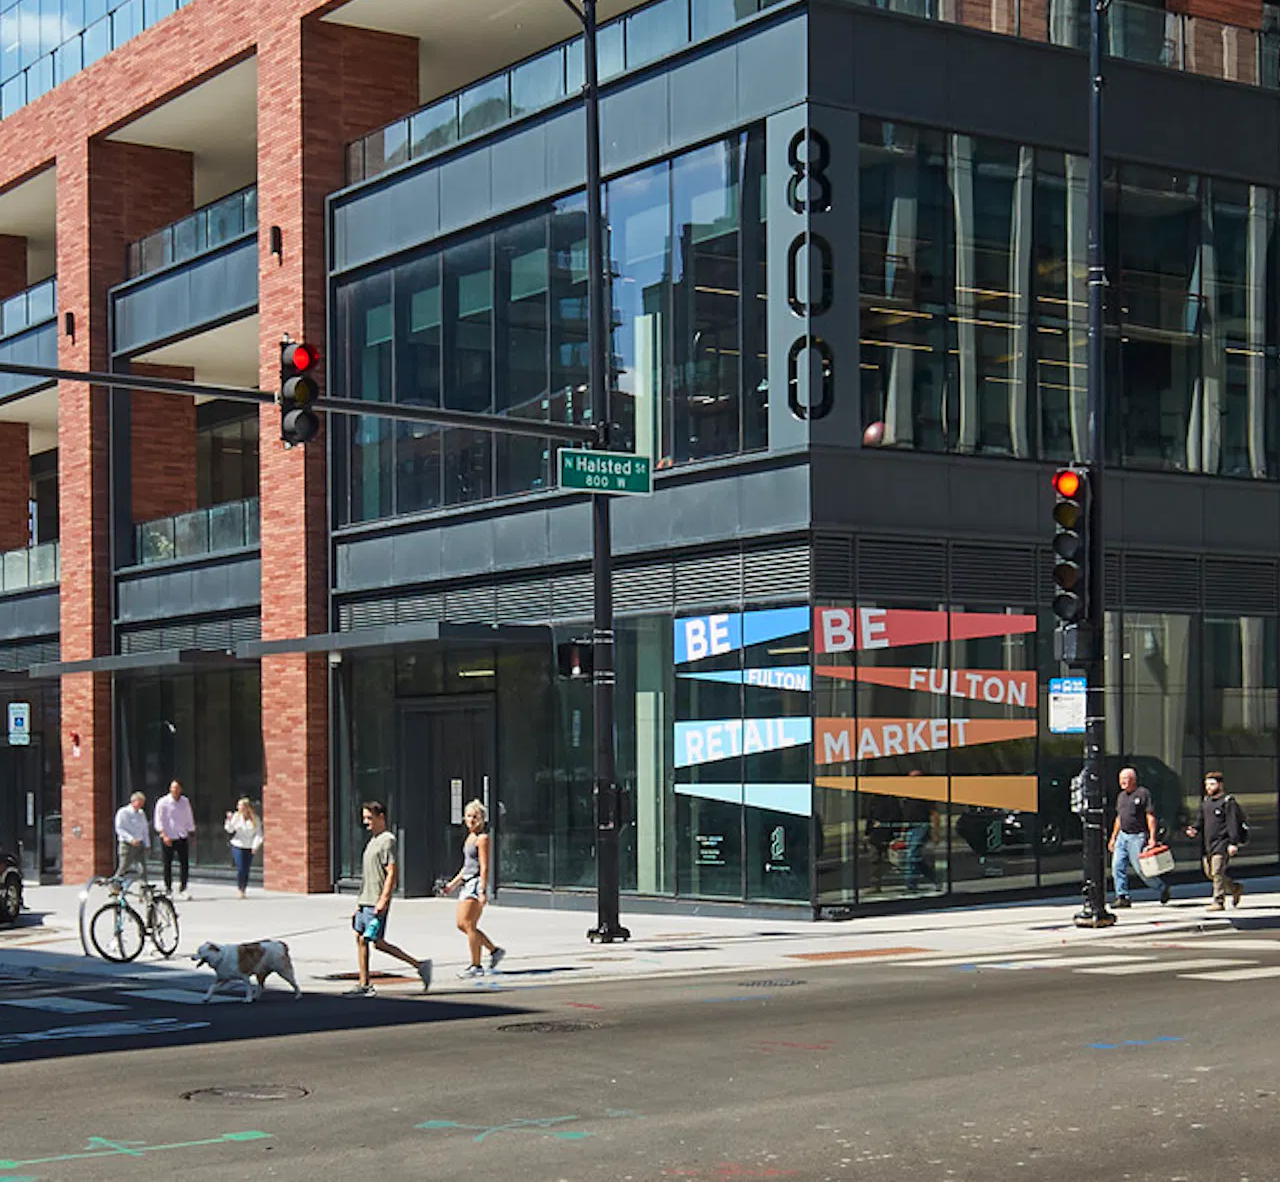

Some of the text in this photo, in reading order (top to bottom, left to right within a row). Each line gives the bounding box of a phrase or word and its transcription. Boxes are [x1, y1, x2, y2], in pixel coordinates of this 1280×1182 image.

[787, 127, 834, 421] 800
[564, 456, 646, 475] N Halsted St
[585, 475, 626, 488] 800 W
[685, 613, 732, 661] BE
[822, 608, 889, 654] BE
[747, 668, 807, 691] FULTON
[910, 668, 1027, 707] FULTON
[685, 717, 796, 765] RETAIL
[824, 718, 970, 763] MARKET
